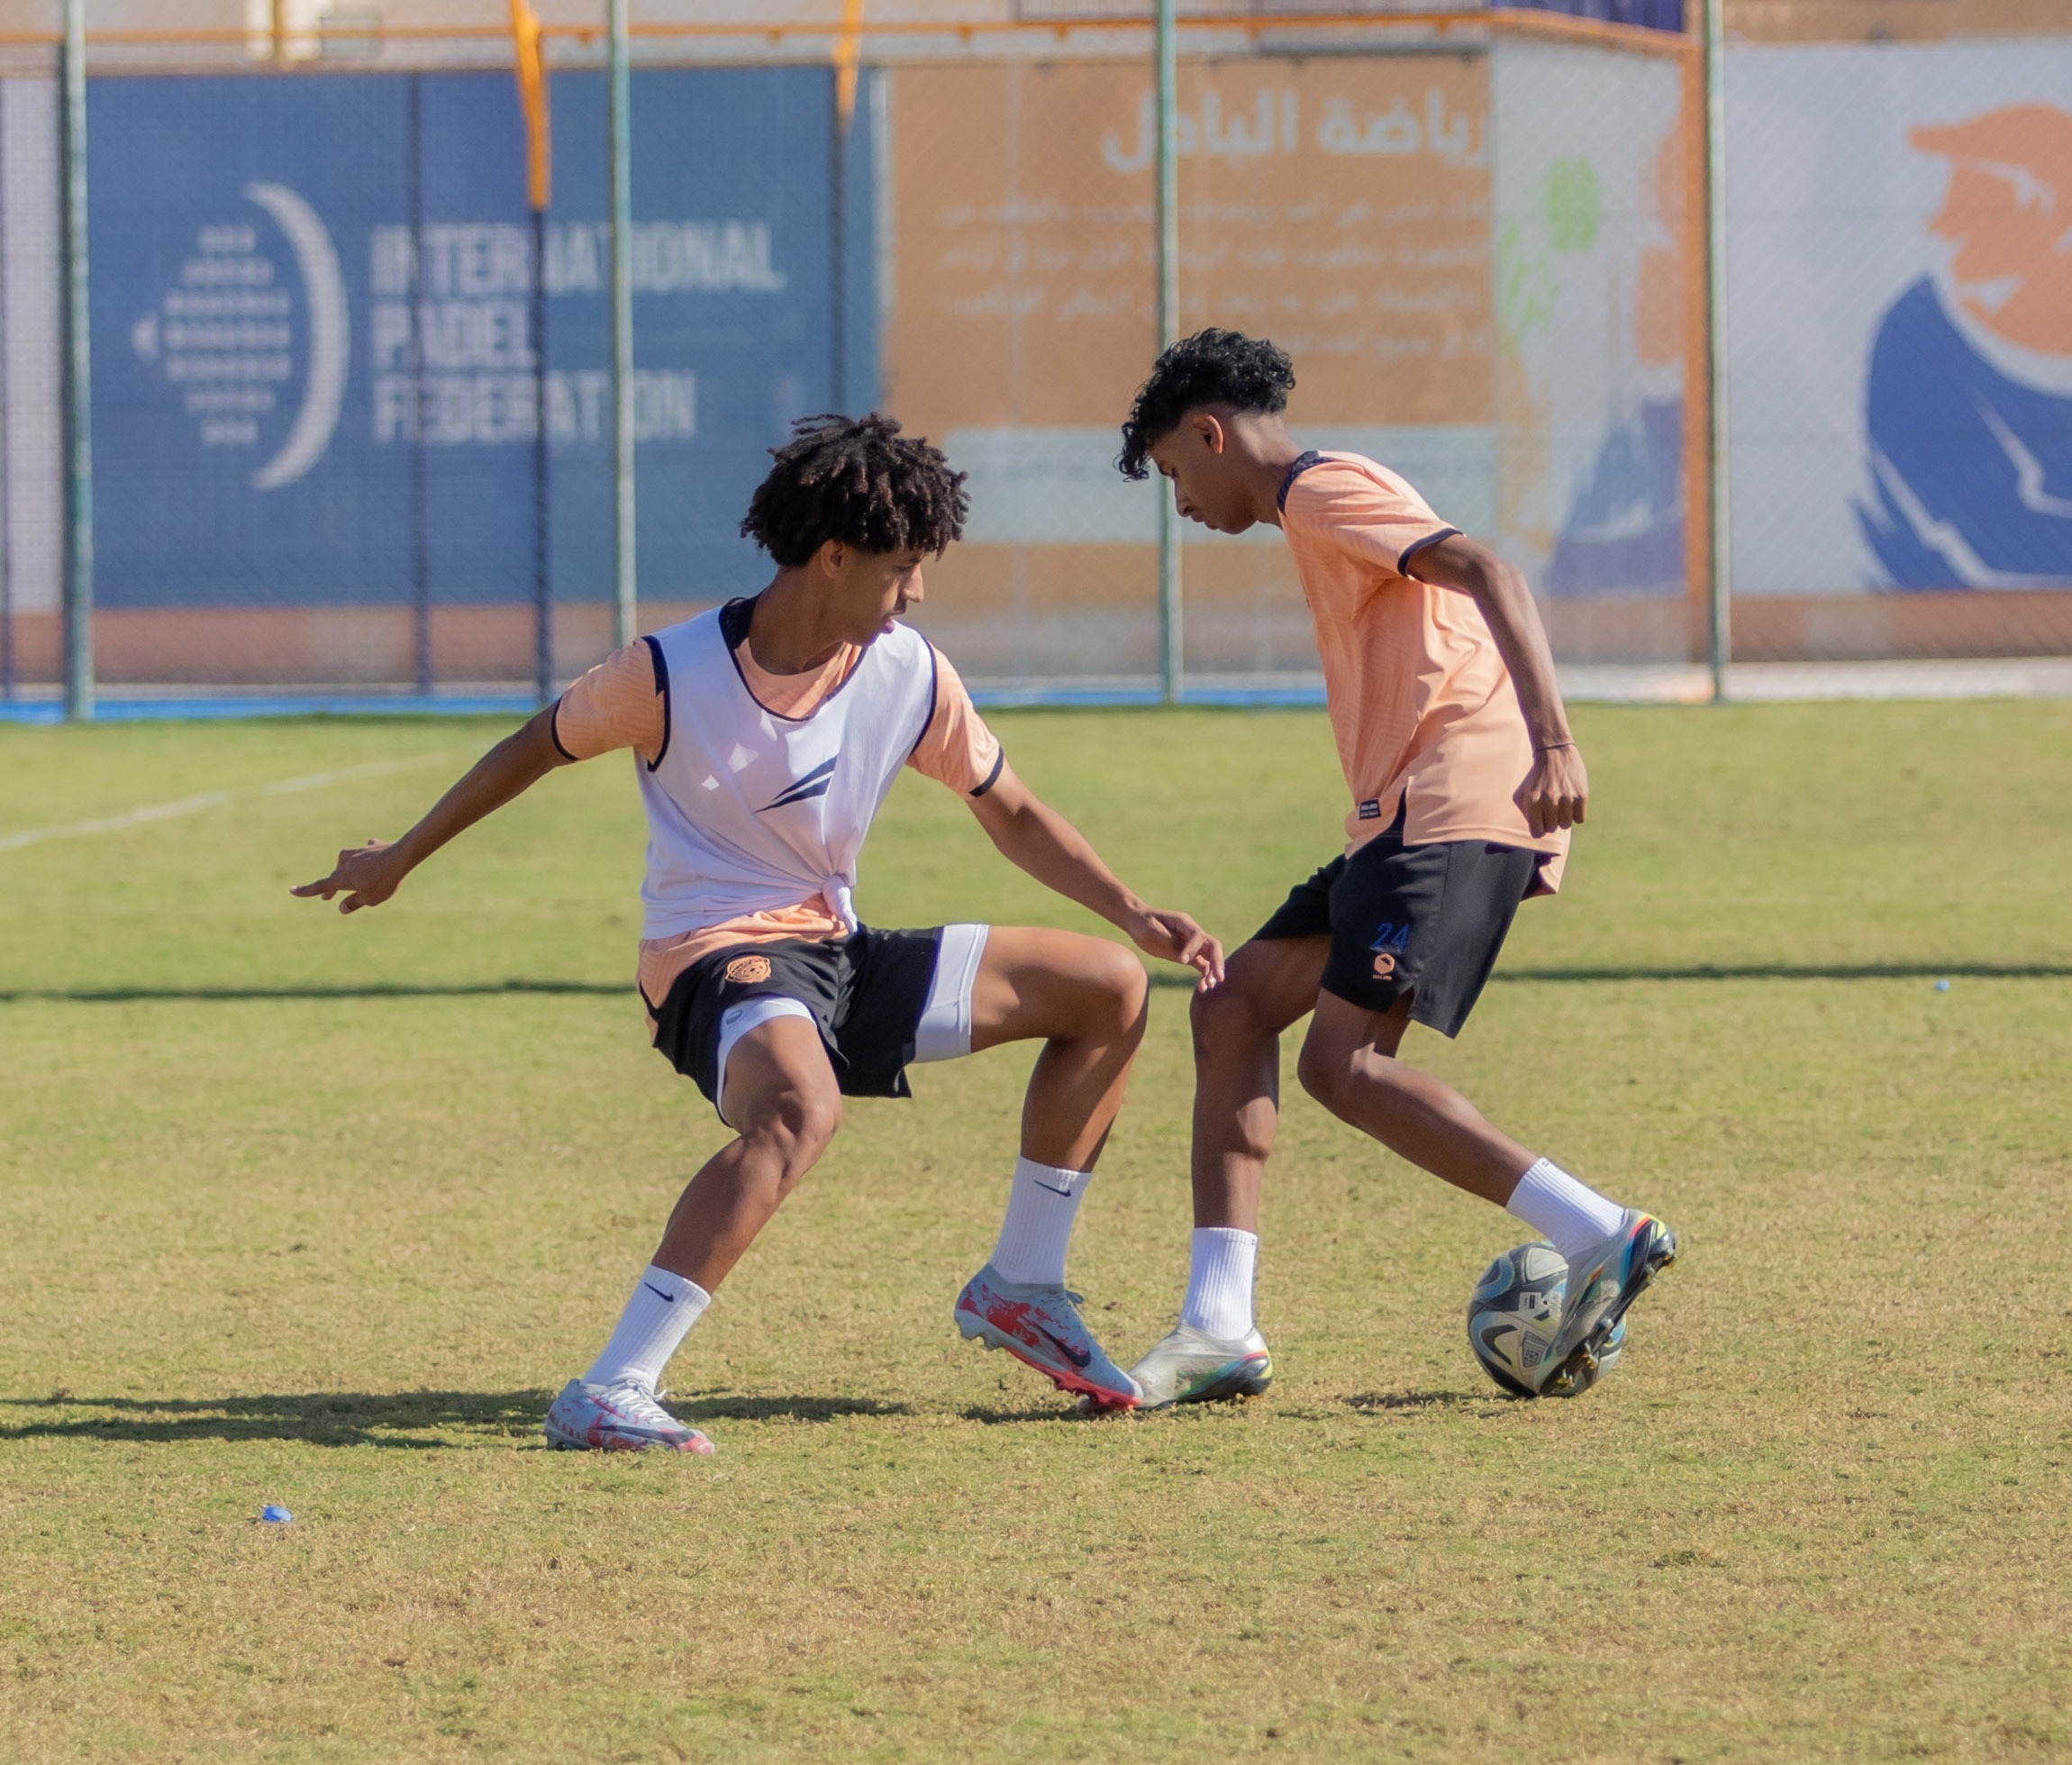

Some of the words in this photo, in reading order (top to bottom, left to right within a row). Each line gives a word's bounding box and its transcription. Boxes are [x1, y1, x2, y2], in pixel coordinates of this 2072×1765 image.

[370, 300, 539, 369] PADEL
[372, 368, 697, 445] FEDERATON
[1369, 923, 1411, 952] 24
